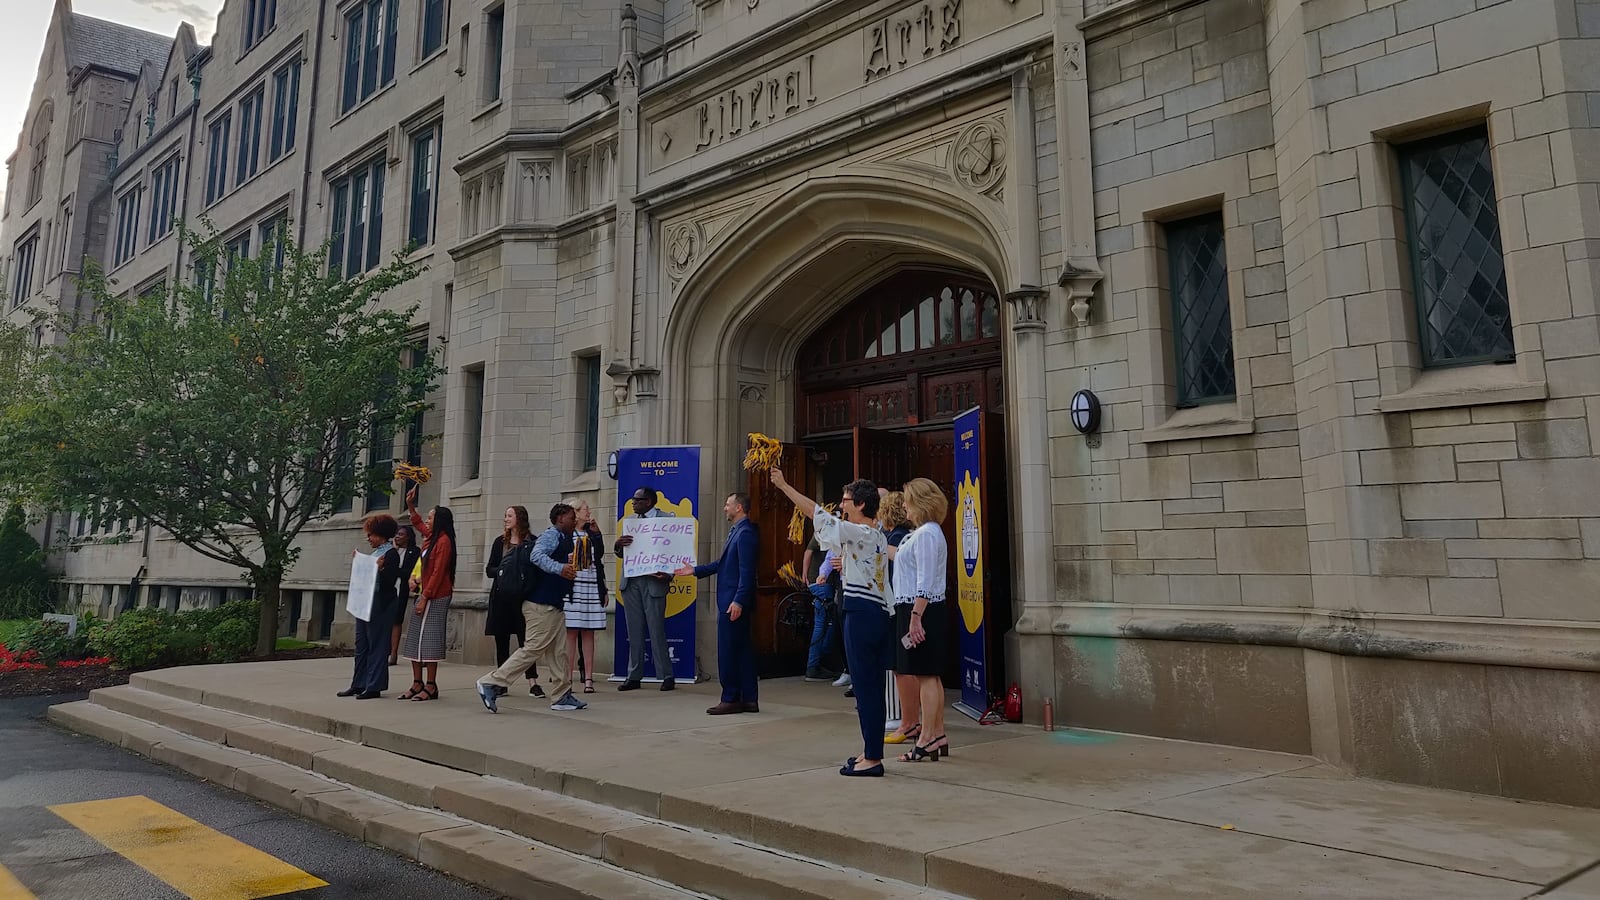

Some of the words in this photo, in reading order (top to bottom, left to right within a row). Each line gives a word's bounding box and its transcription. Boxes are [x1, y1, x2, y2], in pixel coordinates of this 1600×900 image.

[695, 54, 817, 151] Liberal
[866, 0, 961, 81] Arts
[626, 524, 693, 535] WELCOME
